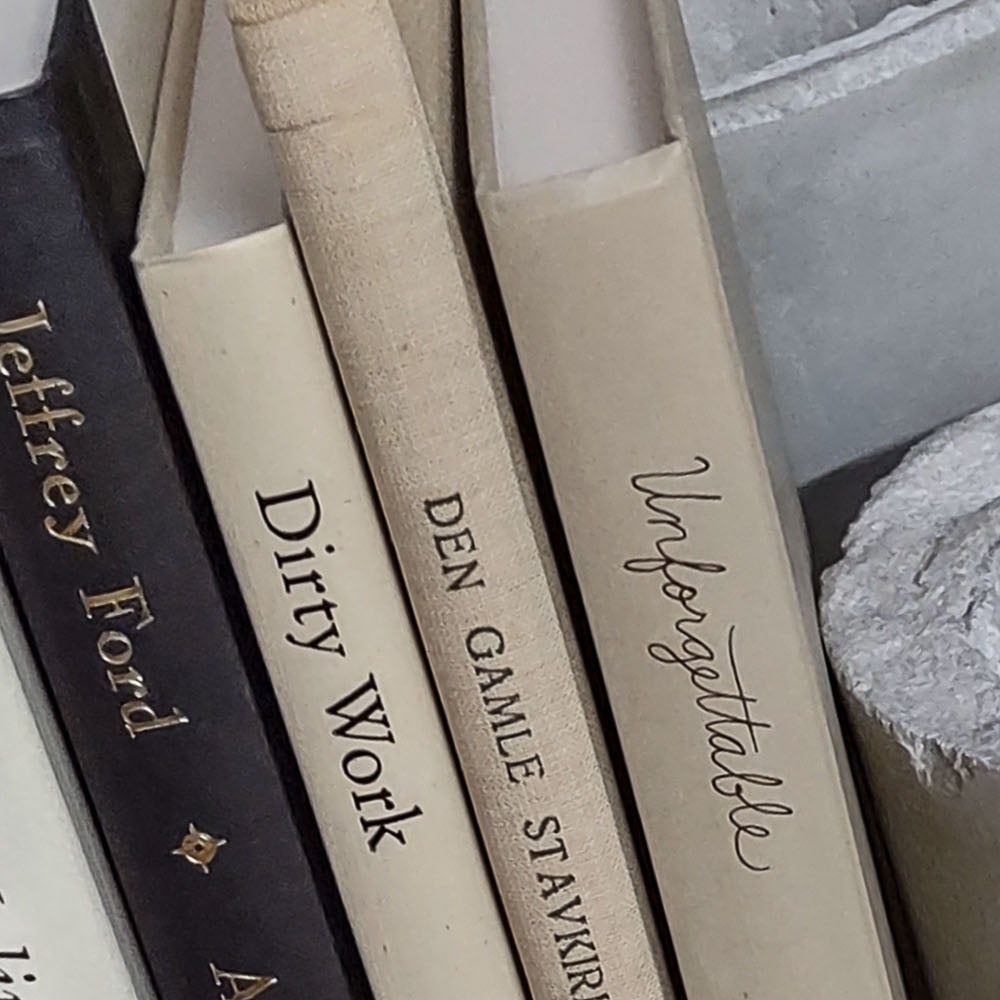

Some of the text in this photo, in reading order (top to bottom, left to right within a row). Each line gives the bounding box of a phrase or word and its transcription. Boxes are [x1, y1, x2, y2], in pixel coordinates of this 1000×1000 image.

[0, 299, 190, 740] Jeffrey Ford
[255, 479, 424, 853] Dirty Work
[423, 493, 487, 594] DEN
[465, 626, 547, 785] GAMLE
[623, 456, 794, 871] Unforgettable
